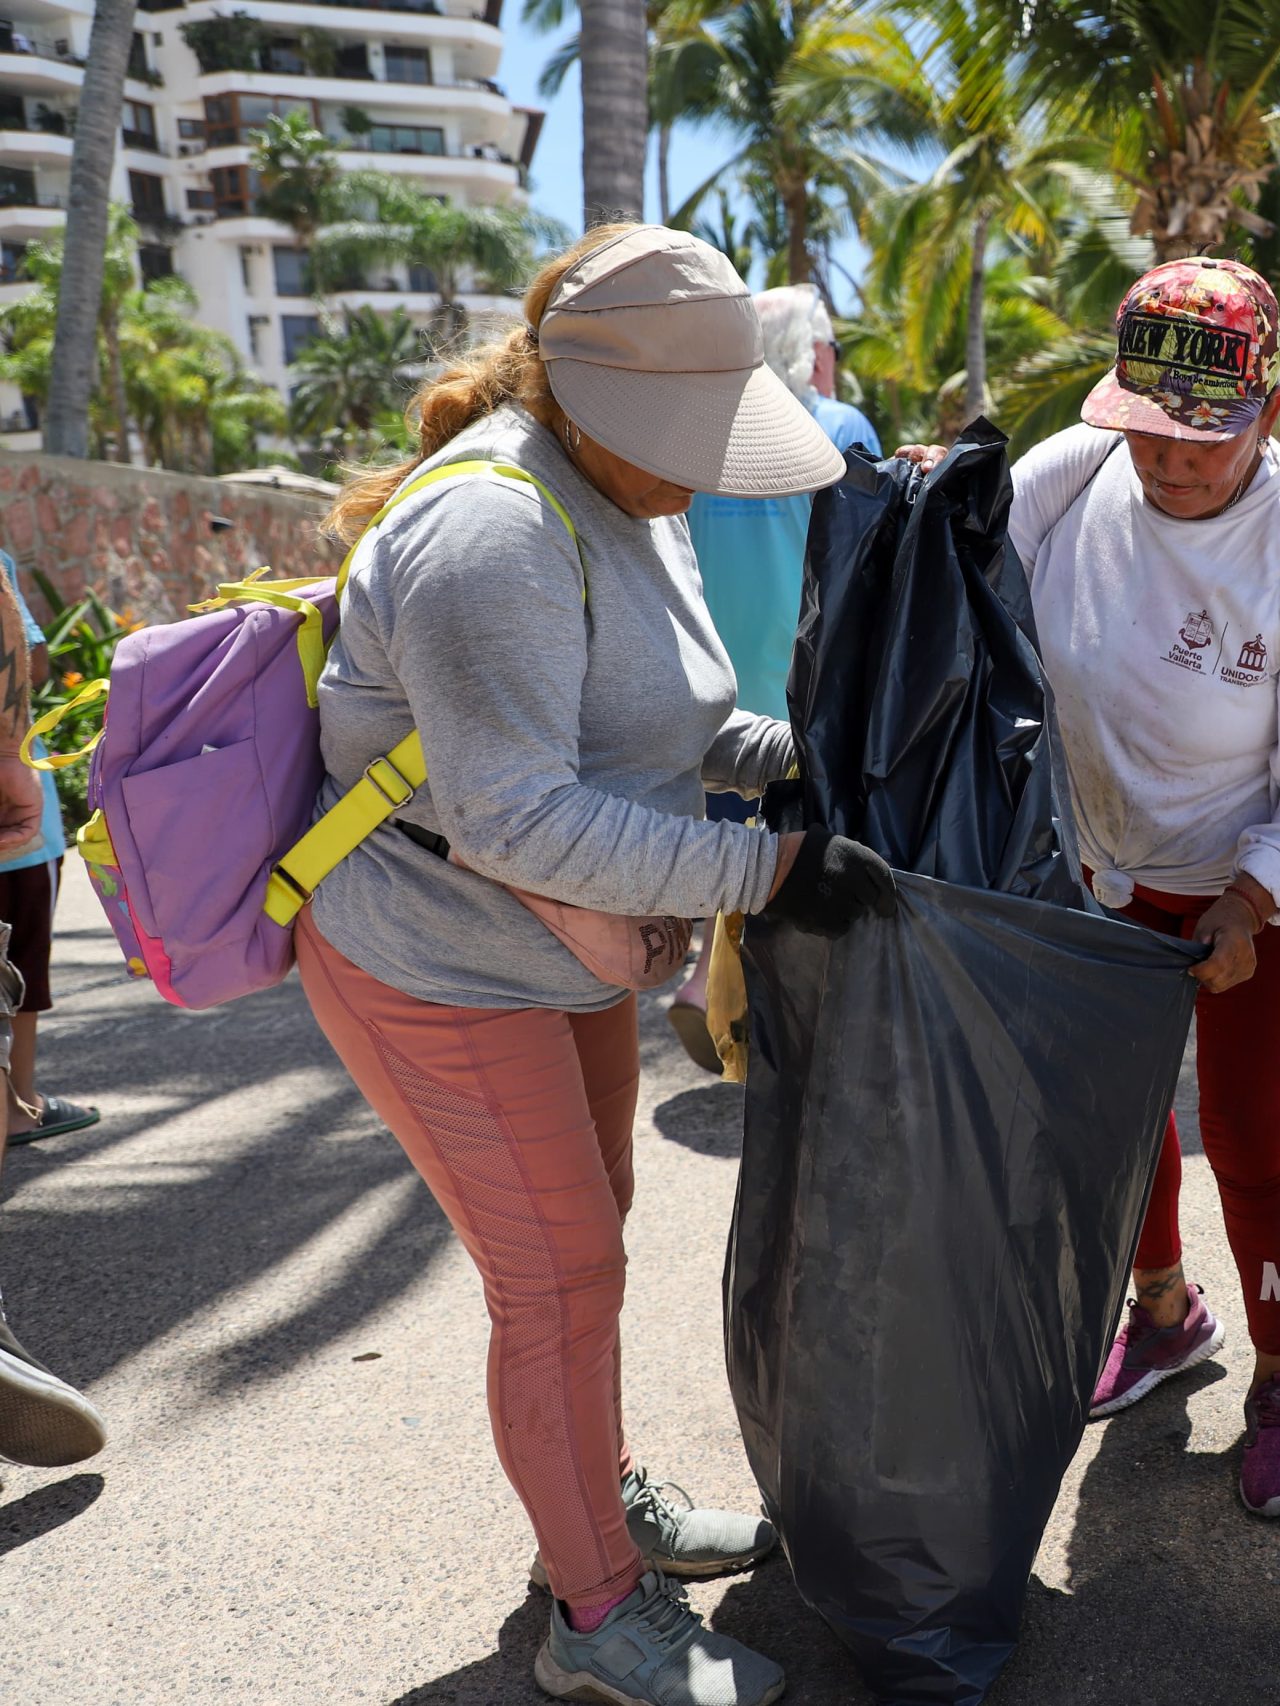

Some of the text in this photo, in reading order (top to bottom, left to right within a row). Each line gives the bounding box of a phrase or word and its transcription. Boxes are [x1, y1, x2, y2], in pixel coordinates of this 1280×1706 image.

[1122, 320, 1244, 372] NEW YORK
[1169, 651, 1202, 669] Vallarta
[1173, 644, 1202, 661] Puerto
[1221, 667, 1259, 682] UNIDOS
